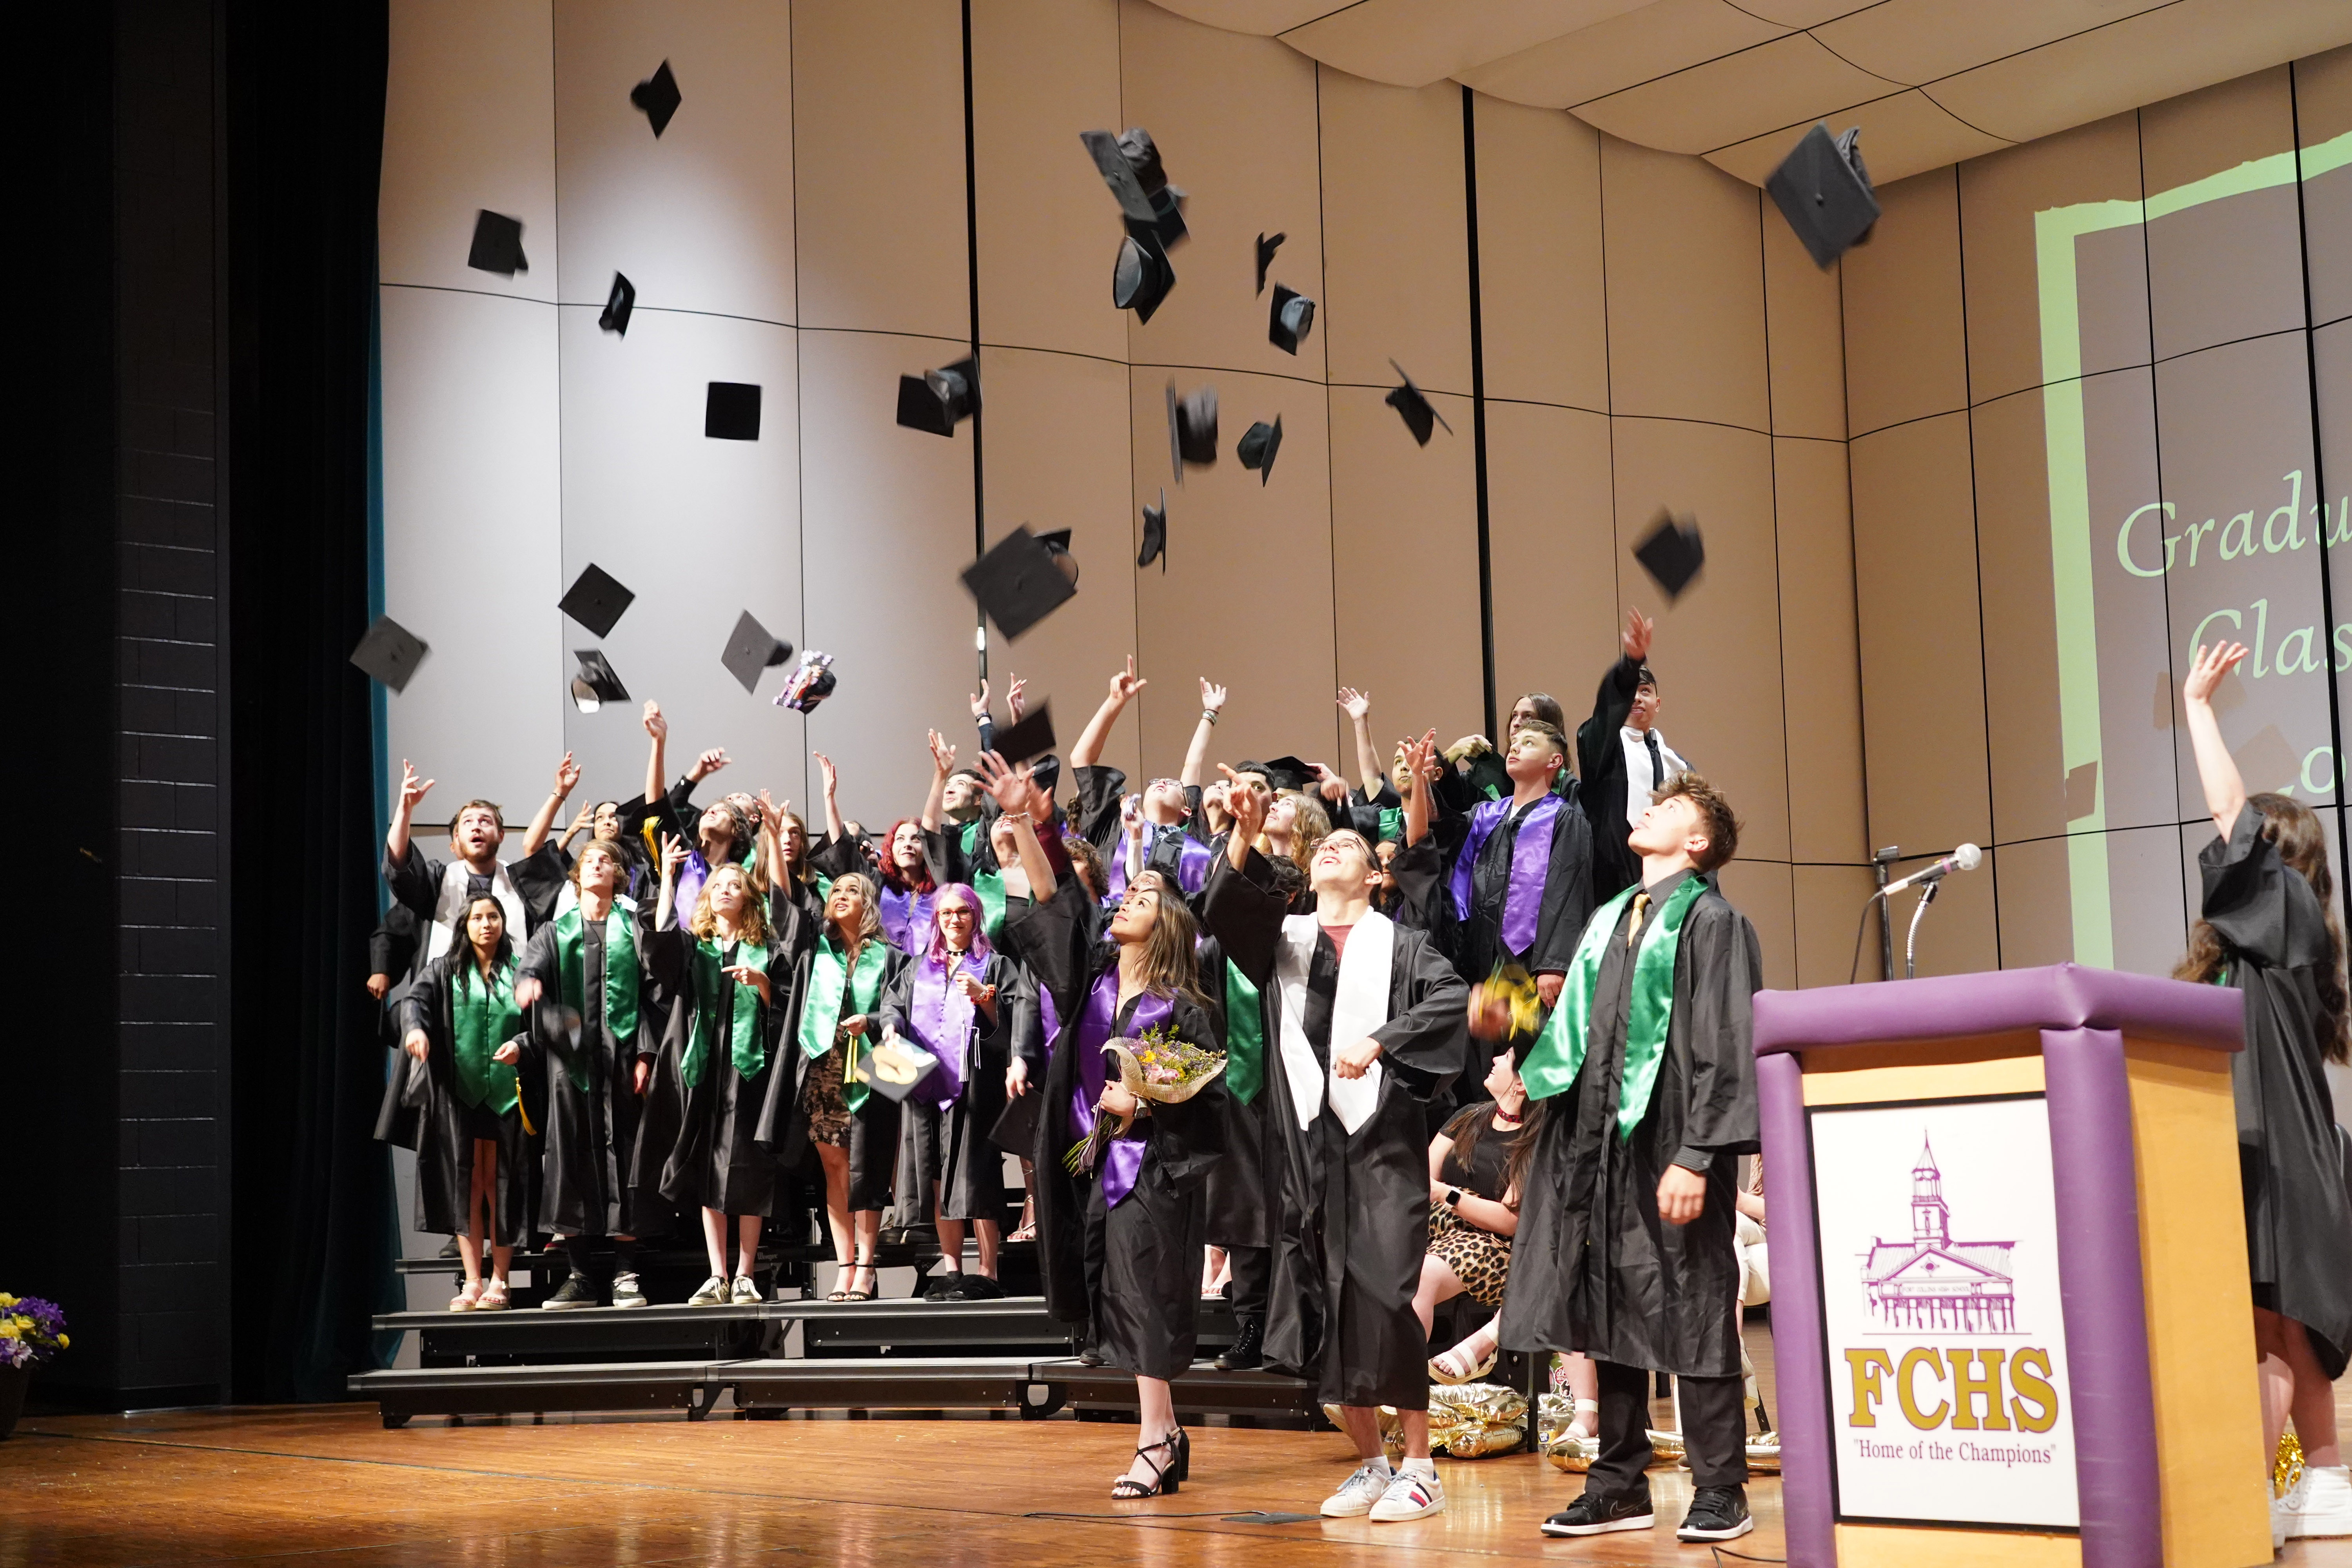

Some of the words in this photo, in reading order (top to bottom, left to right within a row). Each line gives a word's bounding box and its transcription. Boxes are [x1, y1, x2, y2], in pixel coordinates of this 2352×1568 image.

[1844, 1346, 2059, 1434] FCHS
[1854, 1439, 1903, 1459] "Home
[1909, 1441, 1924, 1459] of
[1929, 1441, 1953, 1460] the
[1959, 1442, 2056, 1468] Champions"
